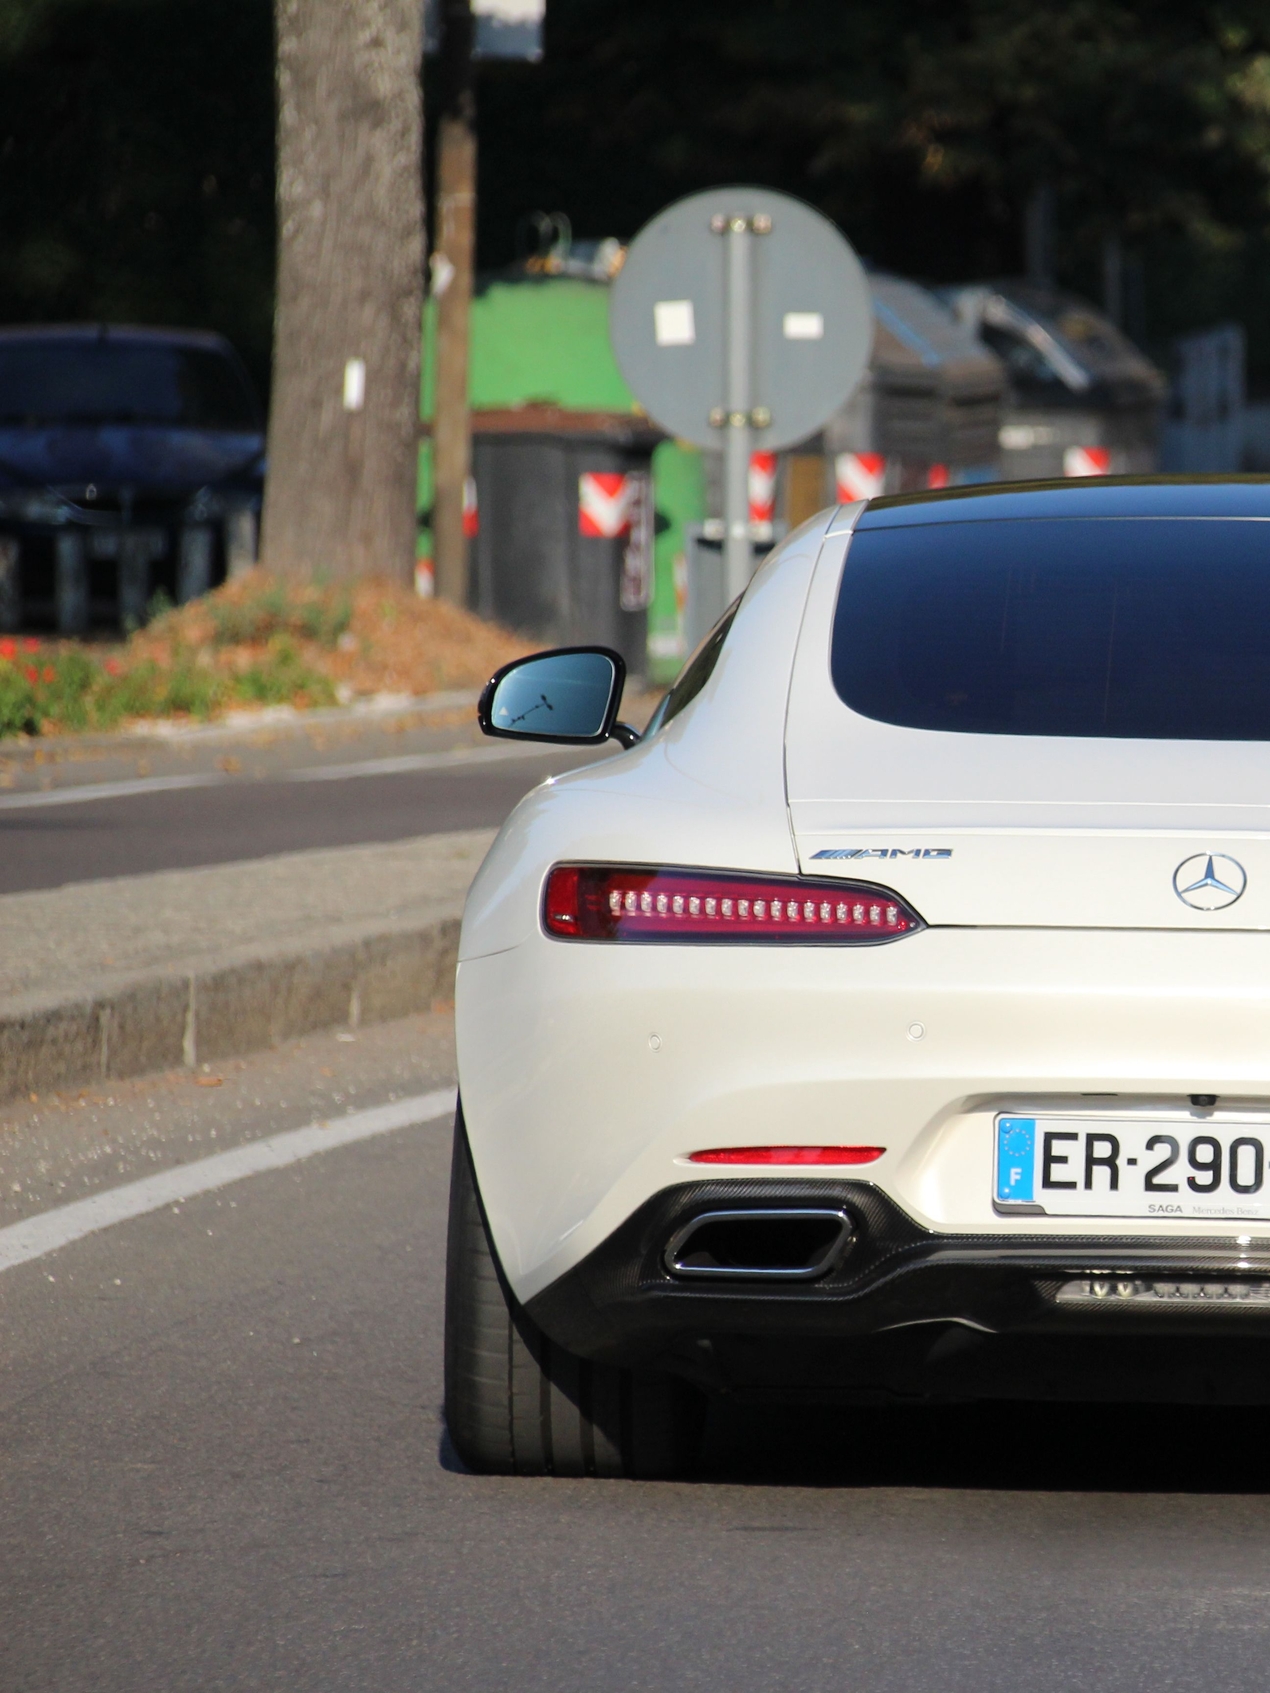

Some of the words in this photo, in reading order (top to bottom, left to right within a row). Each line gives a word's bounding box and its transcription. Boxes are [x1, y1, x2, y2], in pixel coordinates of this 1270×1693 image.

[855, 848, 954, 859] AMG
[1010, 1168, 1022, 1186] F
[1148, 1204, 1183, 1213] SAGA
